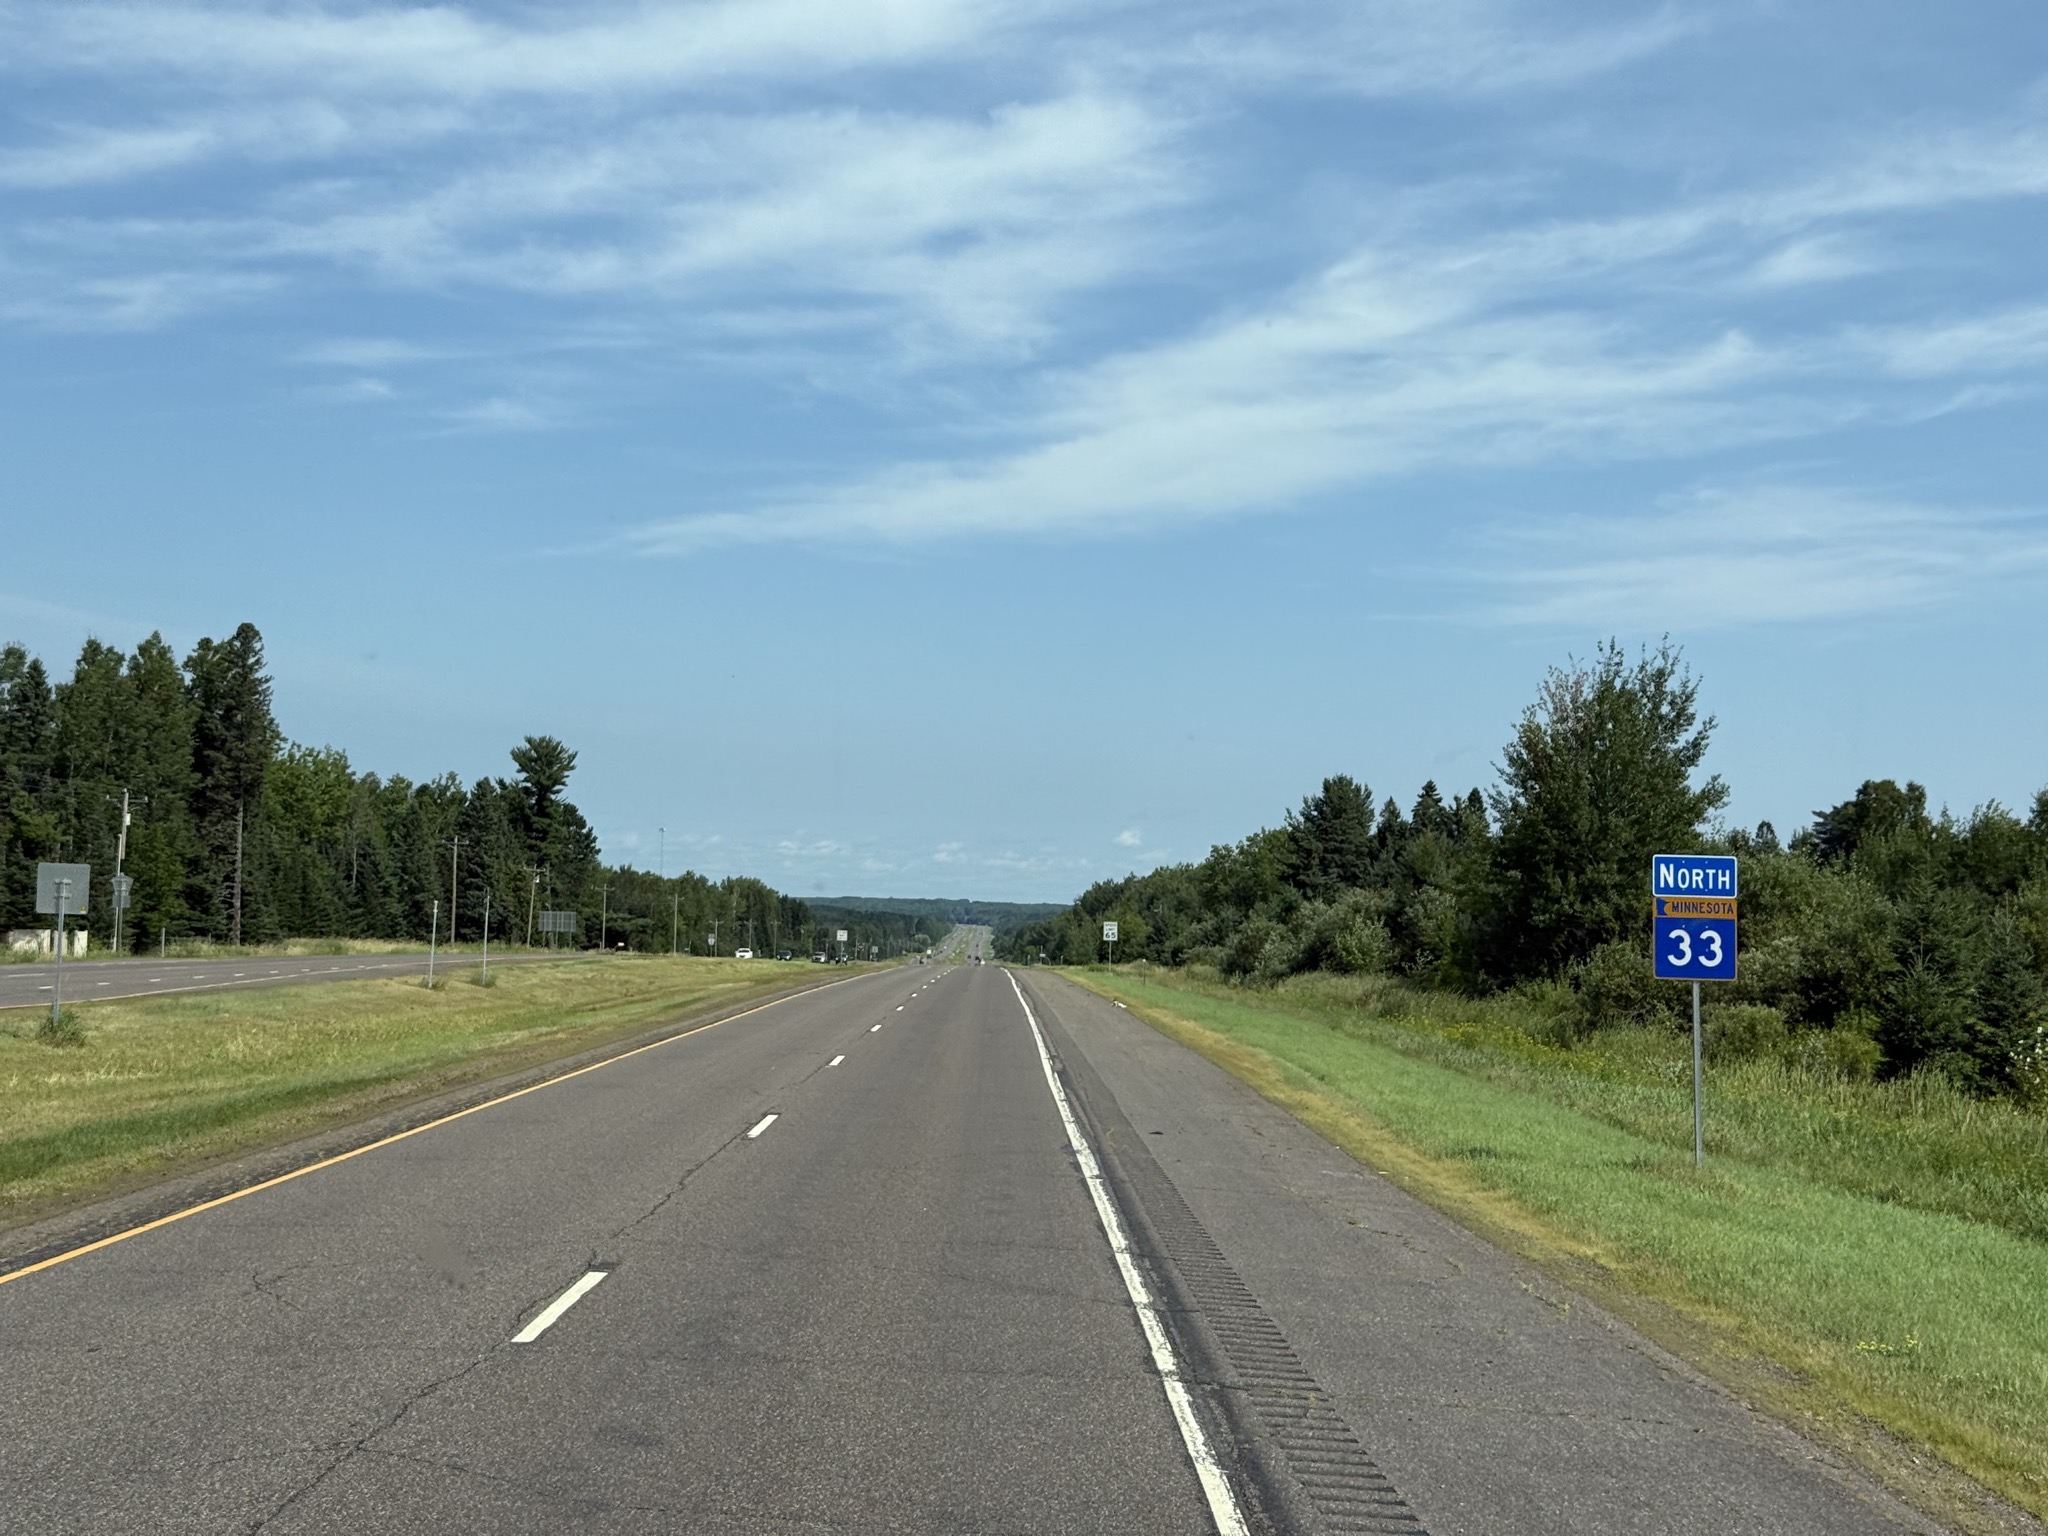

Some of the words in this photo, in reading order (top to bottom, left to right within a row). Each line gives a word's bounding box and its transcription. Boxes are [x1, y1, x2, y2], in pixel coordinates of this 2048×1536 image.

[1659, 863, 1730, 890] NORTH
[1671, 901, 1734, 915] MINNESOTA
[1667, 928, 1723, 968] 33
